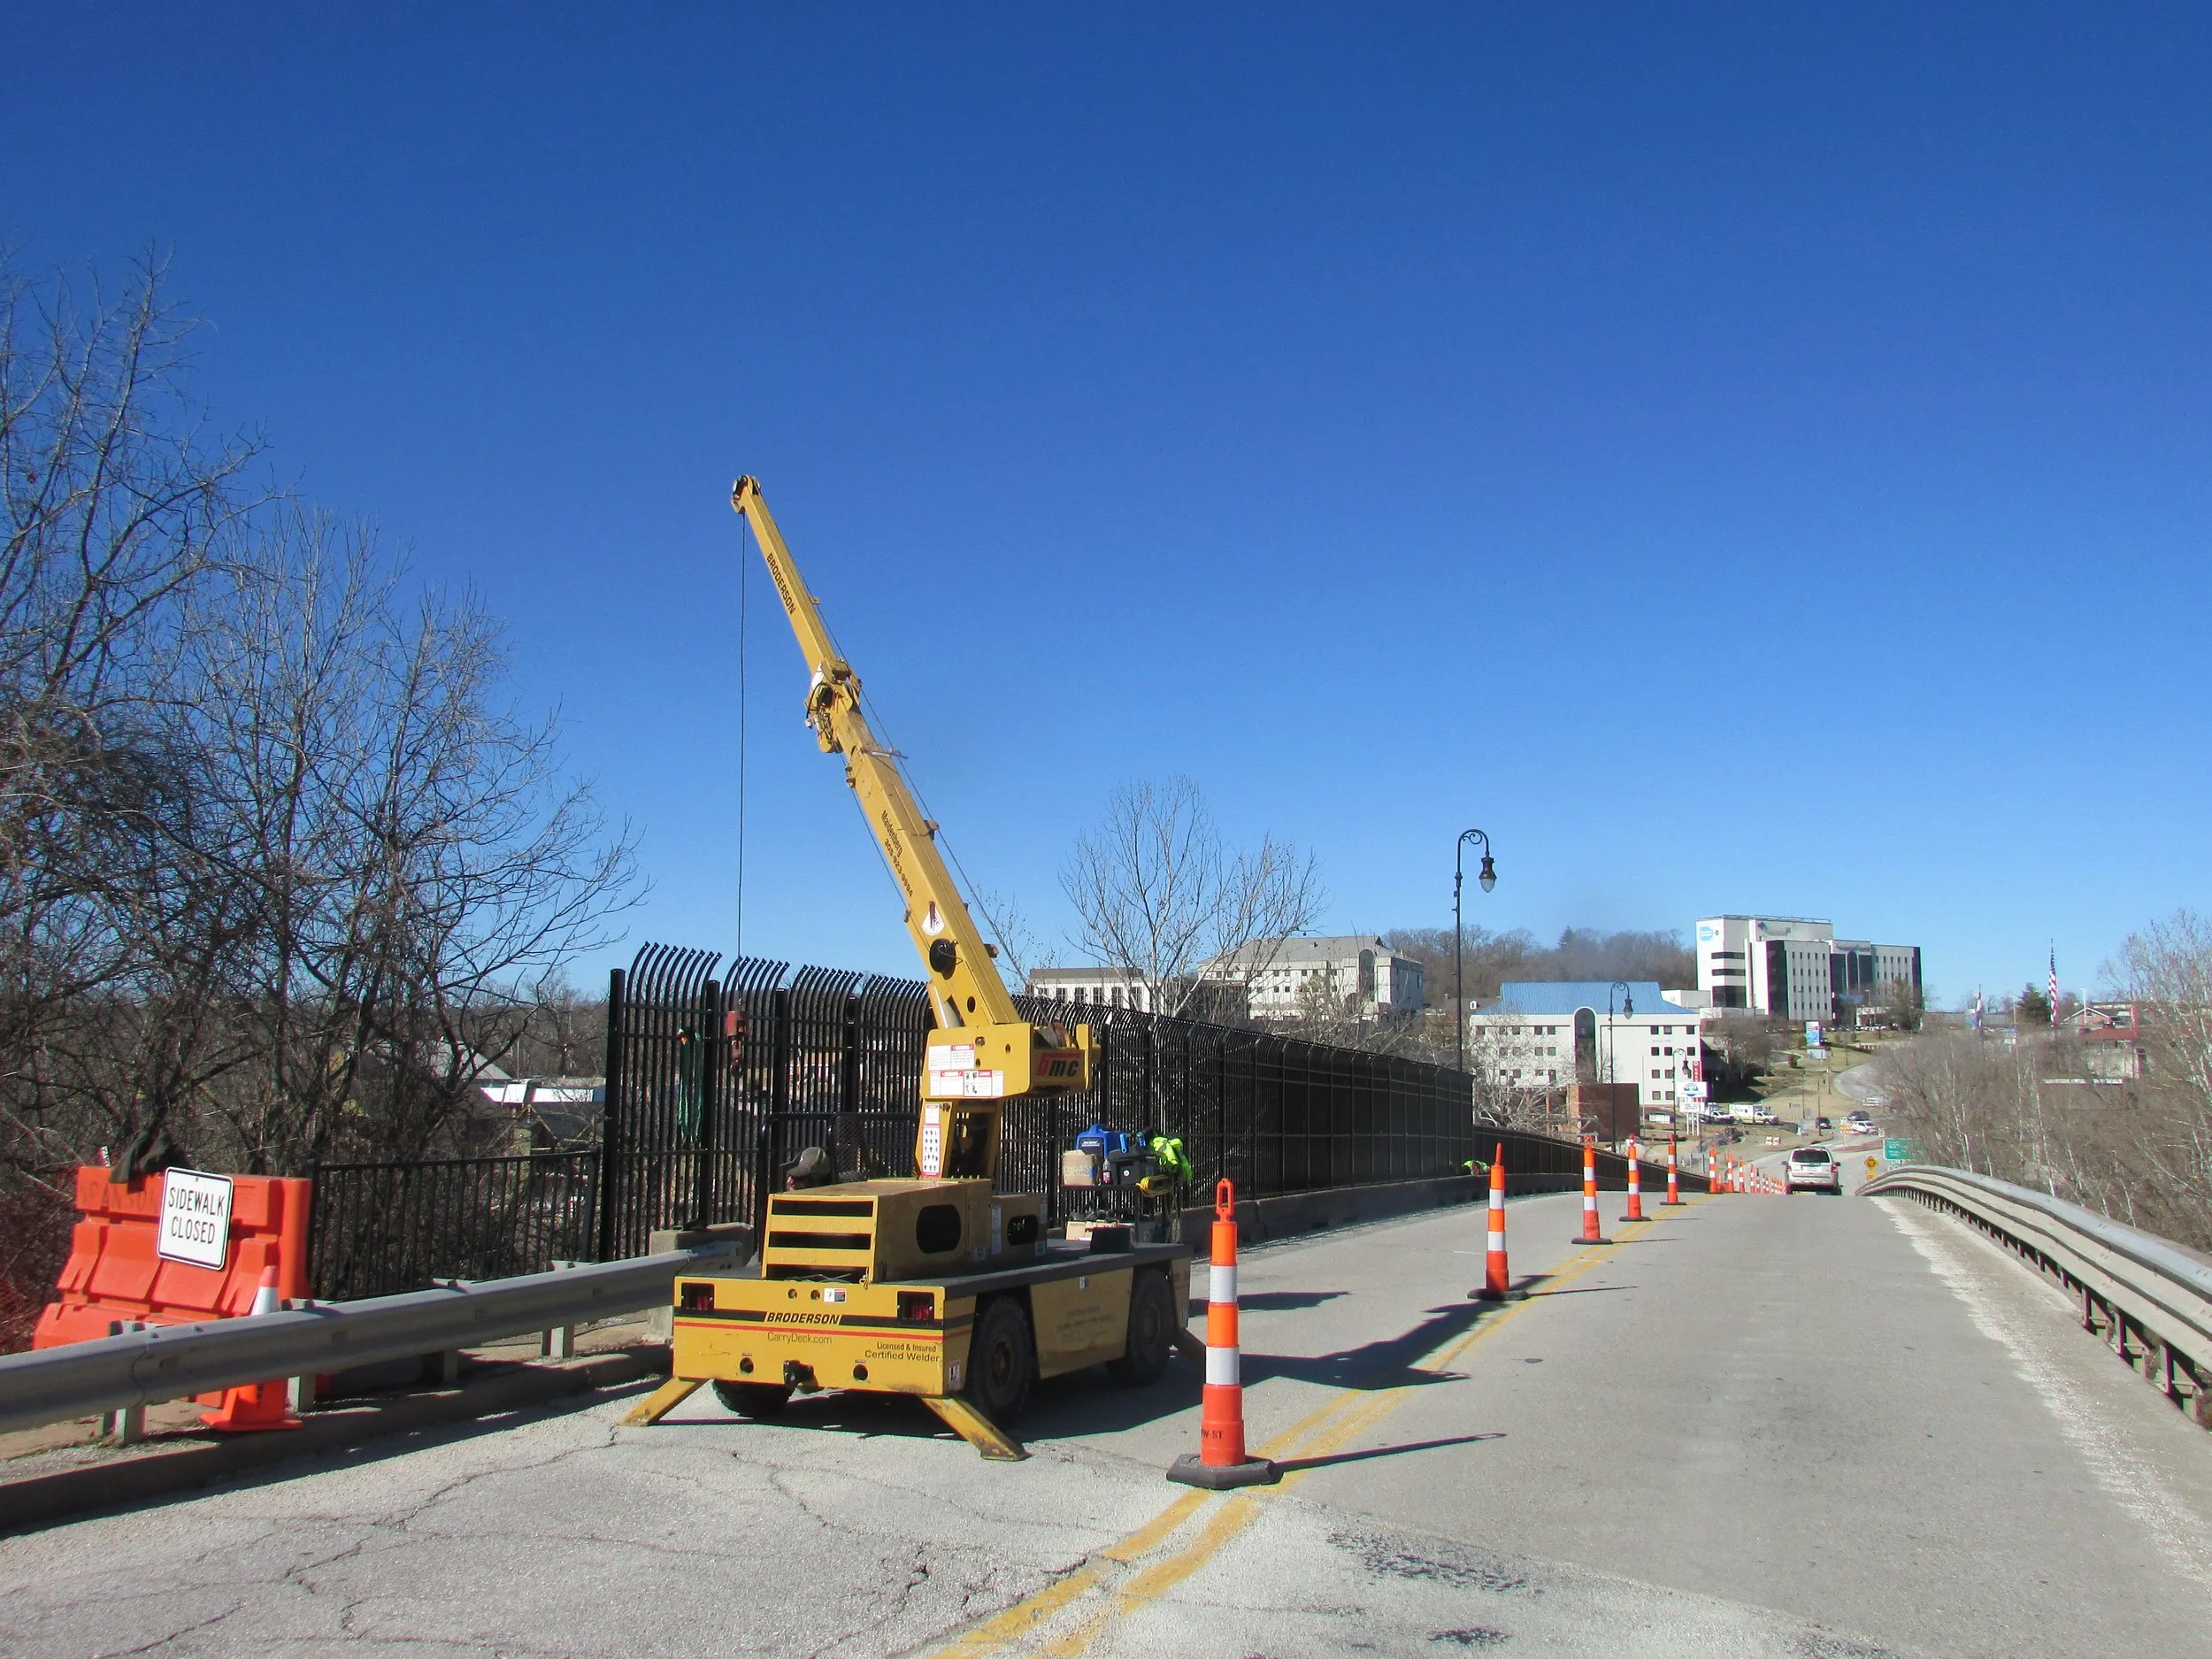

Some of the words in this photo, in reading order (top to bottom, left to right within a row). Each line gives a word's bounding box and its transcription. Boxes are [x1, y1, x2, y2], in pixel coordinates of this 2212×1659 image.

[766, 552, 796, 615] BRODERSON
[168, 1187, 226, 1217] SIDEWALK
[171, 1216, 216, 1244] CLOSED
[766, 1311, 840, 1325] BRODERSON
[767, 1331, 833, 1345] CarryDeck.com
[877, 1341, 904, 1351] Licensed
[905, 1342, 911, 1351] &
[912, 1343, 936, 1353] Insured
[864, 1350, 904, 1360] Certified
[908, 1352, 940, 1363] Welder
